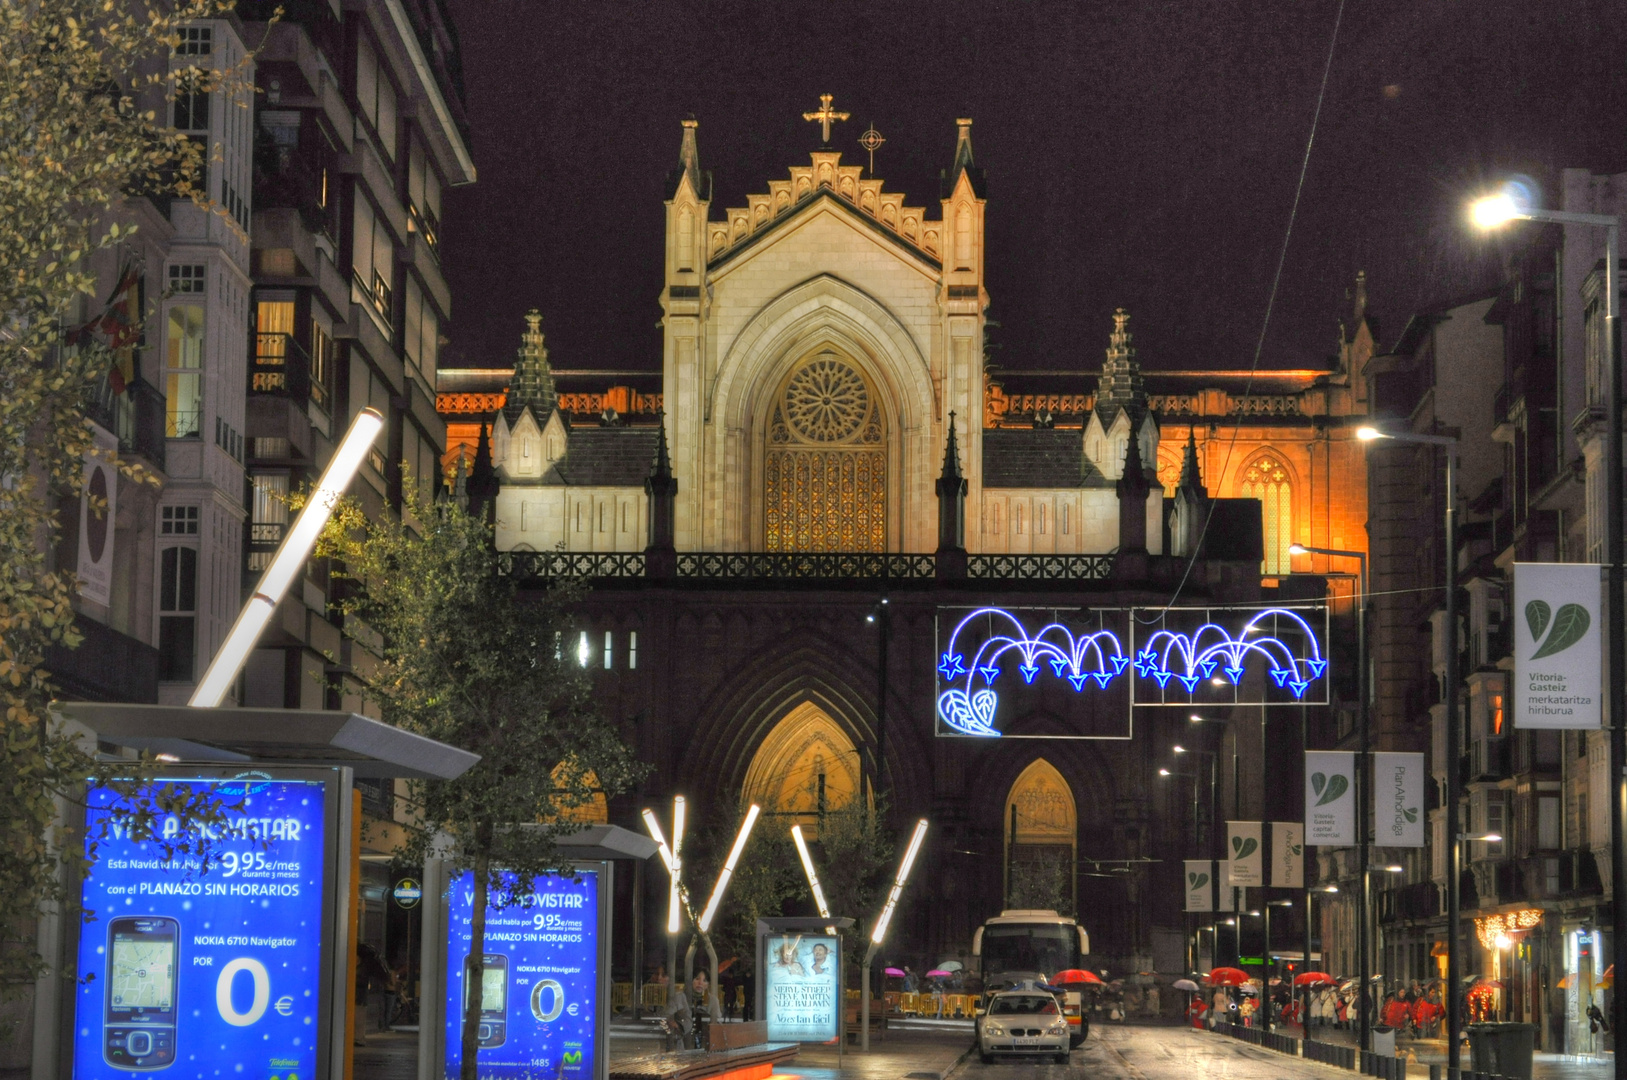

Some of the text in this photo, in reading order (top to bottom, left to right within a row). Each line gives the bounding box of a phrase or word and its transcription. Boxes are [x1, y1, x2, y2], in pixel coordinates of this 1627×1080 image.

[1529, 673, 1567, 682] Vitoria-
[1529, 683, 1567, 692] Gasteiz
[1528, 695, 1591, 704] merkataritza
[1528, 706, 1573, 715] hiriburua
[108, 859, 128, 869] Esta
[129, 859, 170, 870] Navidad
[242, 870, 270, 879] durante
[107, 883, 300, 897] con el PLANAZO SIN HORARIOS
[484, 933, 522, 942] PLANAZO
[523, 933, 537, 942] SIN
[539, 934, 582, 942] HORARIOS
[194, 936, 296, 949] NOKIA 6710 Navigator
[193, 957, 212, 966] POR
[551, 966, 581, 975] Navigator
[216, 958, 294, 1027] 0 €
[530, 979, 579, 1022] 0 €
[796, 1015, 810, 1024] tan
[813, 1014, 830, 1024] fácil
[531, 1059, 550, 1067] 1485
